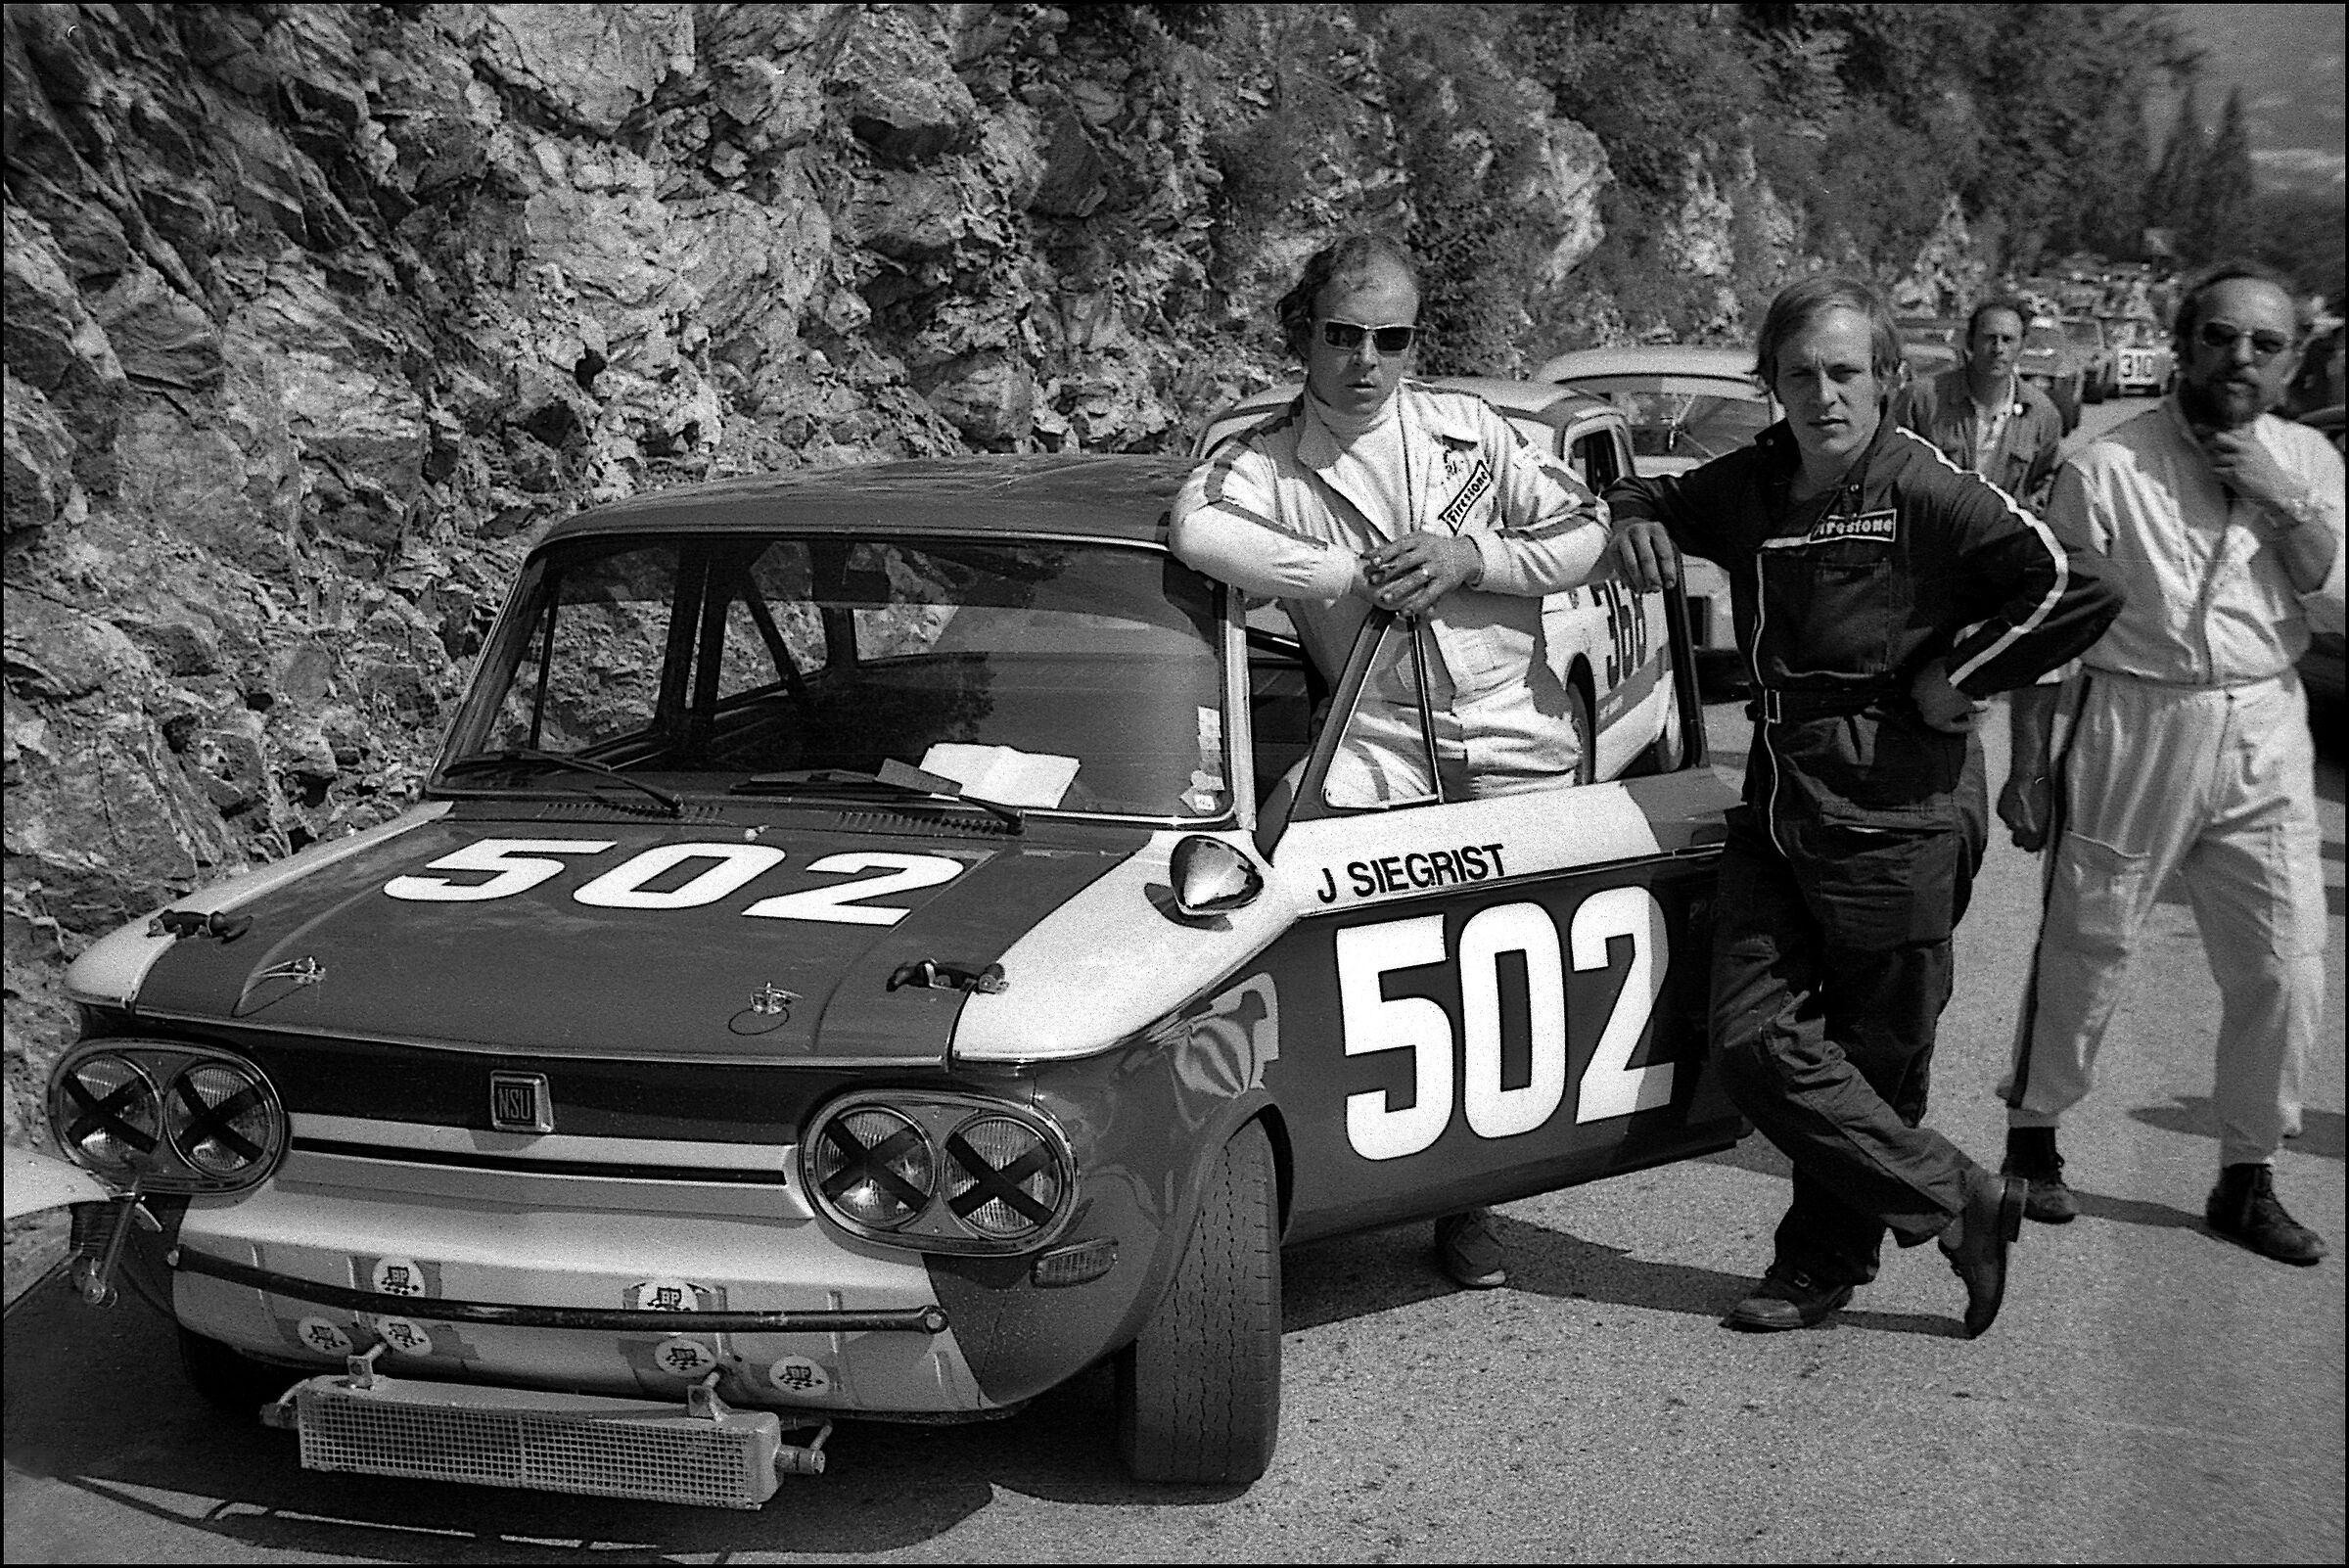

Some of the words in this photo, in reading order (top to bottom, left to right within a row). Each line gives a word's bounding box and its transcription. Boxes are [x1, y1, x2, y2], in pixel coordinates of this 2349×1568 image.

[1447, 471, 1489, 524] Firestone
[383, 838, 964, 926] 502
[1317, 867, 1338, 903] J
[1347, 843, 1505, 898] SIEGRIST
[1335, 885, 1676, 1162] 502
[497, 1086, 531, 1121] NSU
[392, 1268, 408, 1283] BP
[660, 1290, 681, 1305] BP
